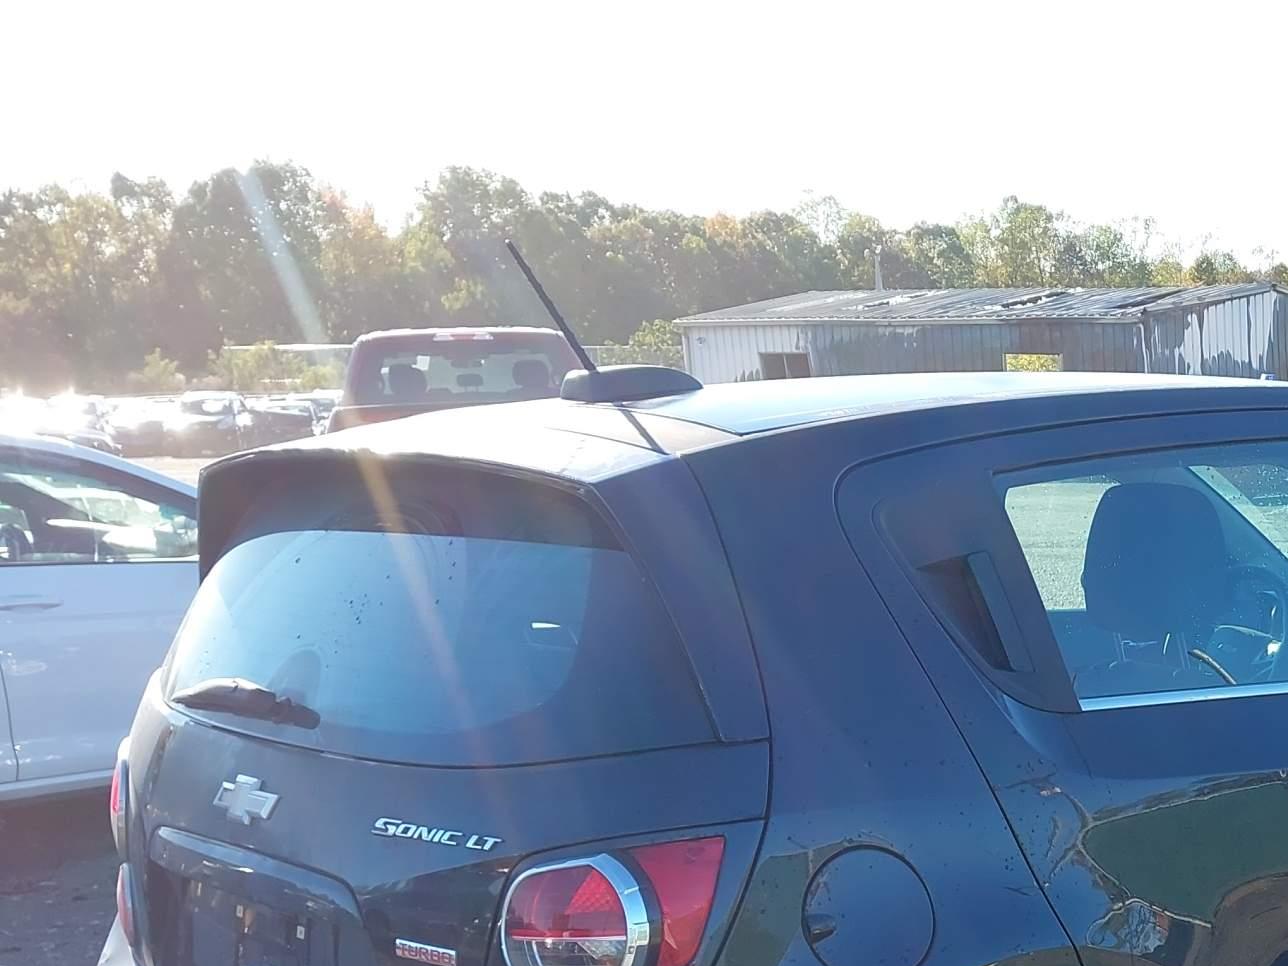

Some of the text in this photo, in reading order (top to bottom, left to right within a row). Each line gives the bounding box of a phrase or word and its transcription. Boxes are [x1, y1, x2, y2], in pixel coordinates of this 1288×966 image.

[371, 817, 503, 851] SONIC LT
[397, 942, 454, 965] TURBO
